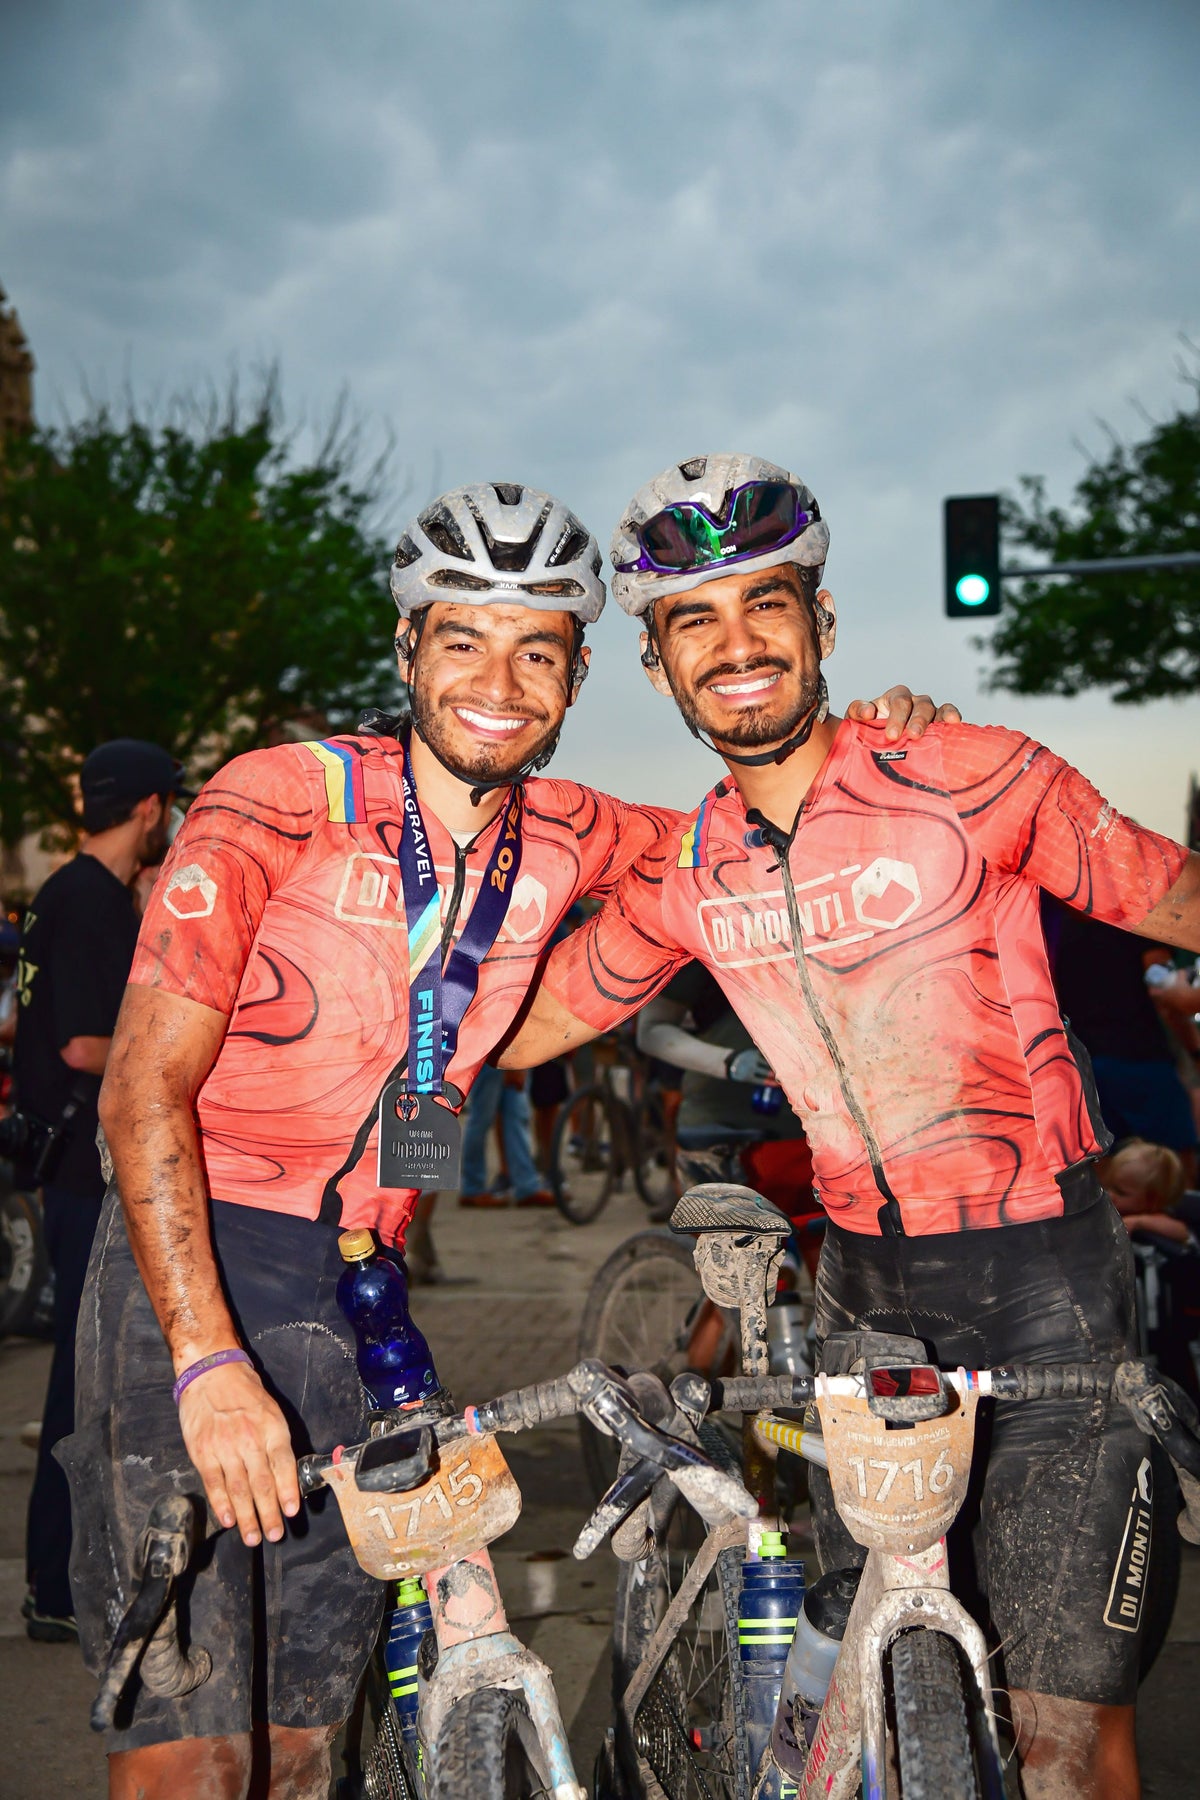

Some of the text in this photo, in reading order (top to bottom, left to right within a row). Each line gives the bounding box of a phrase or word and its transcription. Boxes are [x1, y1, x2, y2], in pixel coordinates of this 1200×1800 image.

[404, 798, 432, 886] GRAVEL
[491, 846, 514, 893] 20
[357, 871, 390, 910] DI
[711, 891, 846, 953] DI MONTI
[365, 1459, 484, 1540] 1715
[847, 1447, 954, 1503] 1716
[1119, 1508, 1151, 1619] DI MONTI
